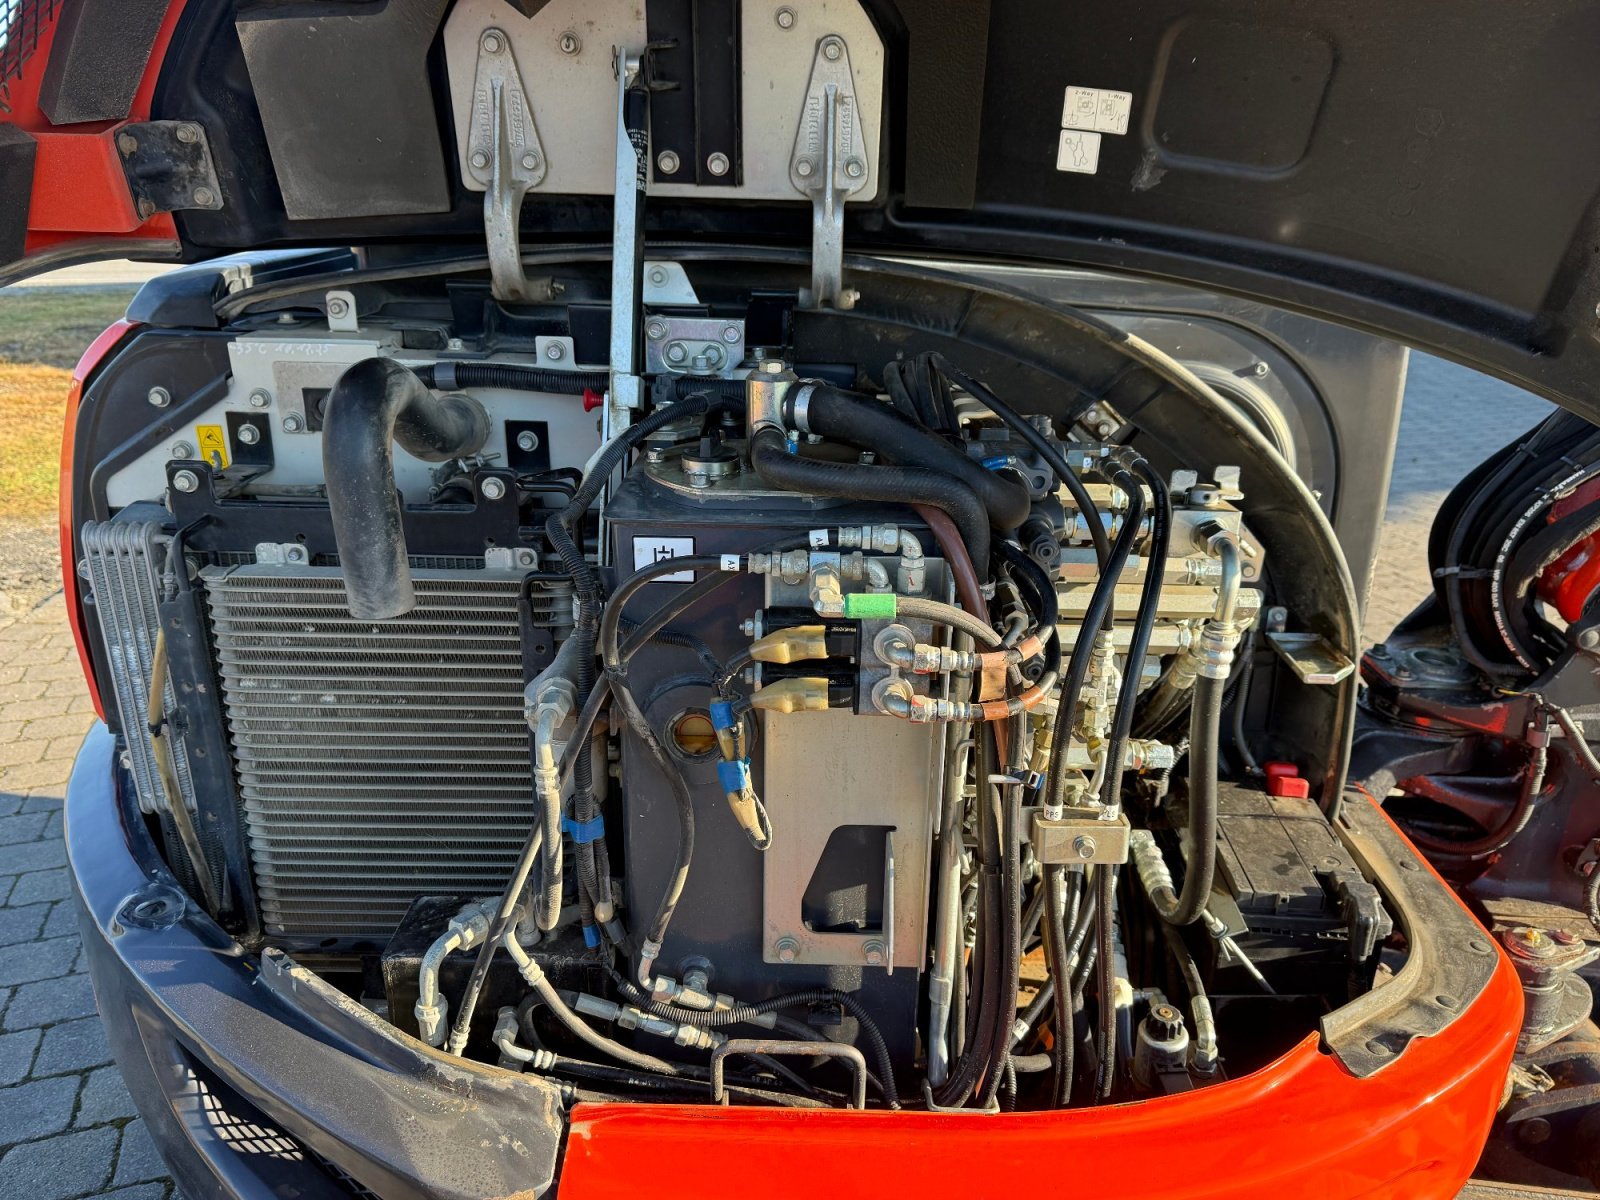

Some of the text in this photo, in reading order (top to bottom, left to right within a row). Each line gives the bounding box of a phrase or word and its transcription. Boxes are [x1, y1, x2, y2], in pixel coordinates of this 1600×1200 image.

[1074, 89, 1094, 97] 2-Way
[1107, 93, 1126, 101] 1-Way
[1045, 809, 1059, 818] PPS
